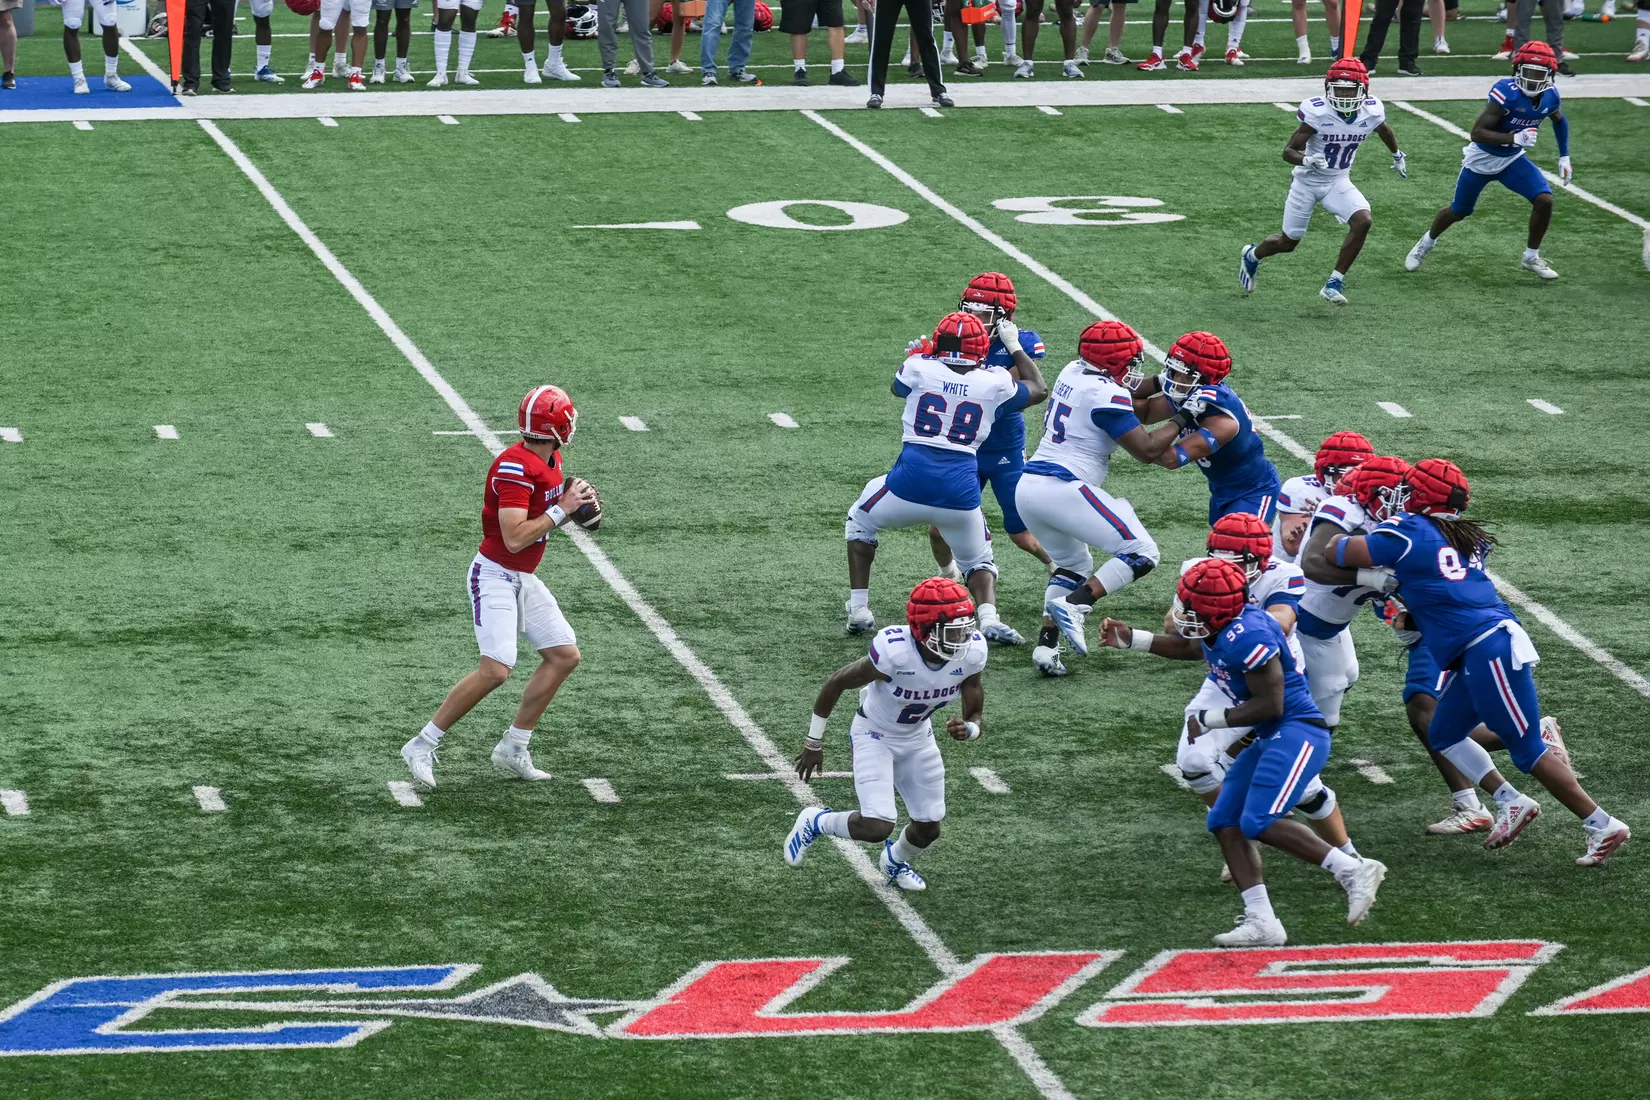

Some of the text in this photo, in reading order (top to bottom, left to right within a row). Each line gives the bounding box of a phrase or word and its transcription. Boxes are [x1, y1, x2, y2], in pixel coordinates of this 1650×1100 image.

[1322, 133, 1367, 142] BULLDOGS
[1323, 142, 1359, 170] 80
[943, 381, 969, 397] WHITE
[914, 391, 983, 446] 68
[884, 627, 906, 644] 21
[1226, 623, 1245, 642] 93
